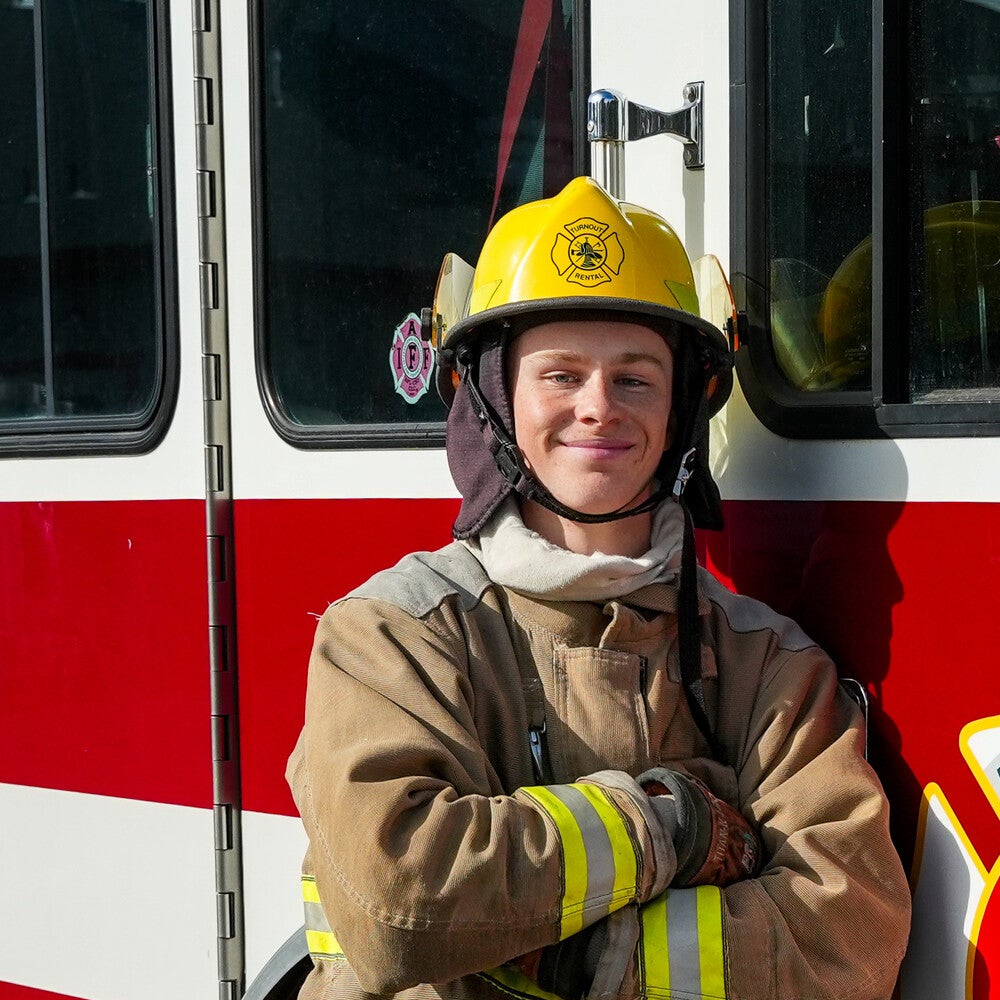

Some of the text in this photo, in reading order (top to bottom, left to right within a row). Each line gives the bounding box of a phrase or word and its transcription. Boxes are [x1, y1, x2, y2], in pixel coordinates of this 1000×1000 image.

[571, 224, 603, 234] TURNOUT
[574, 272, 604, 281] RENTAL
[408, 321, 417, 335] A
